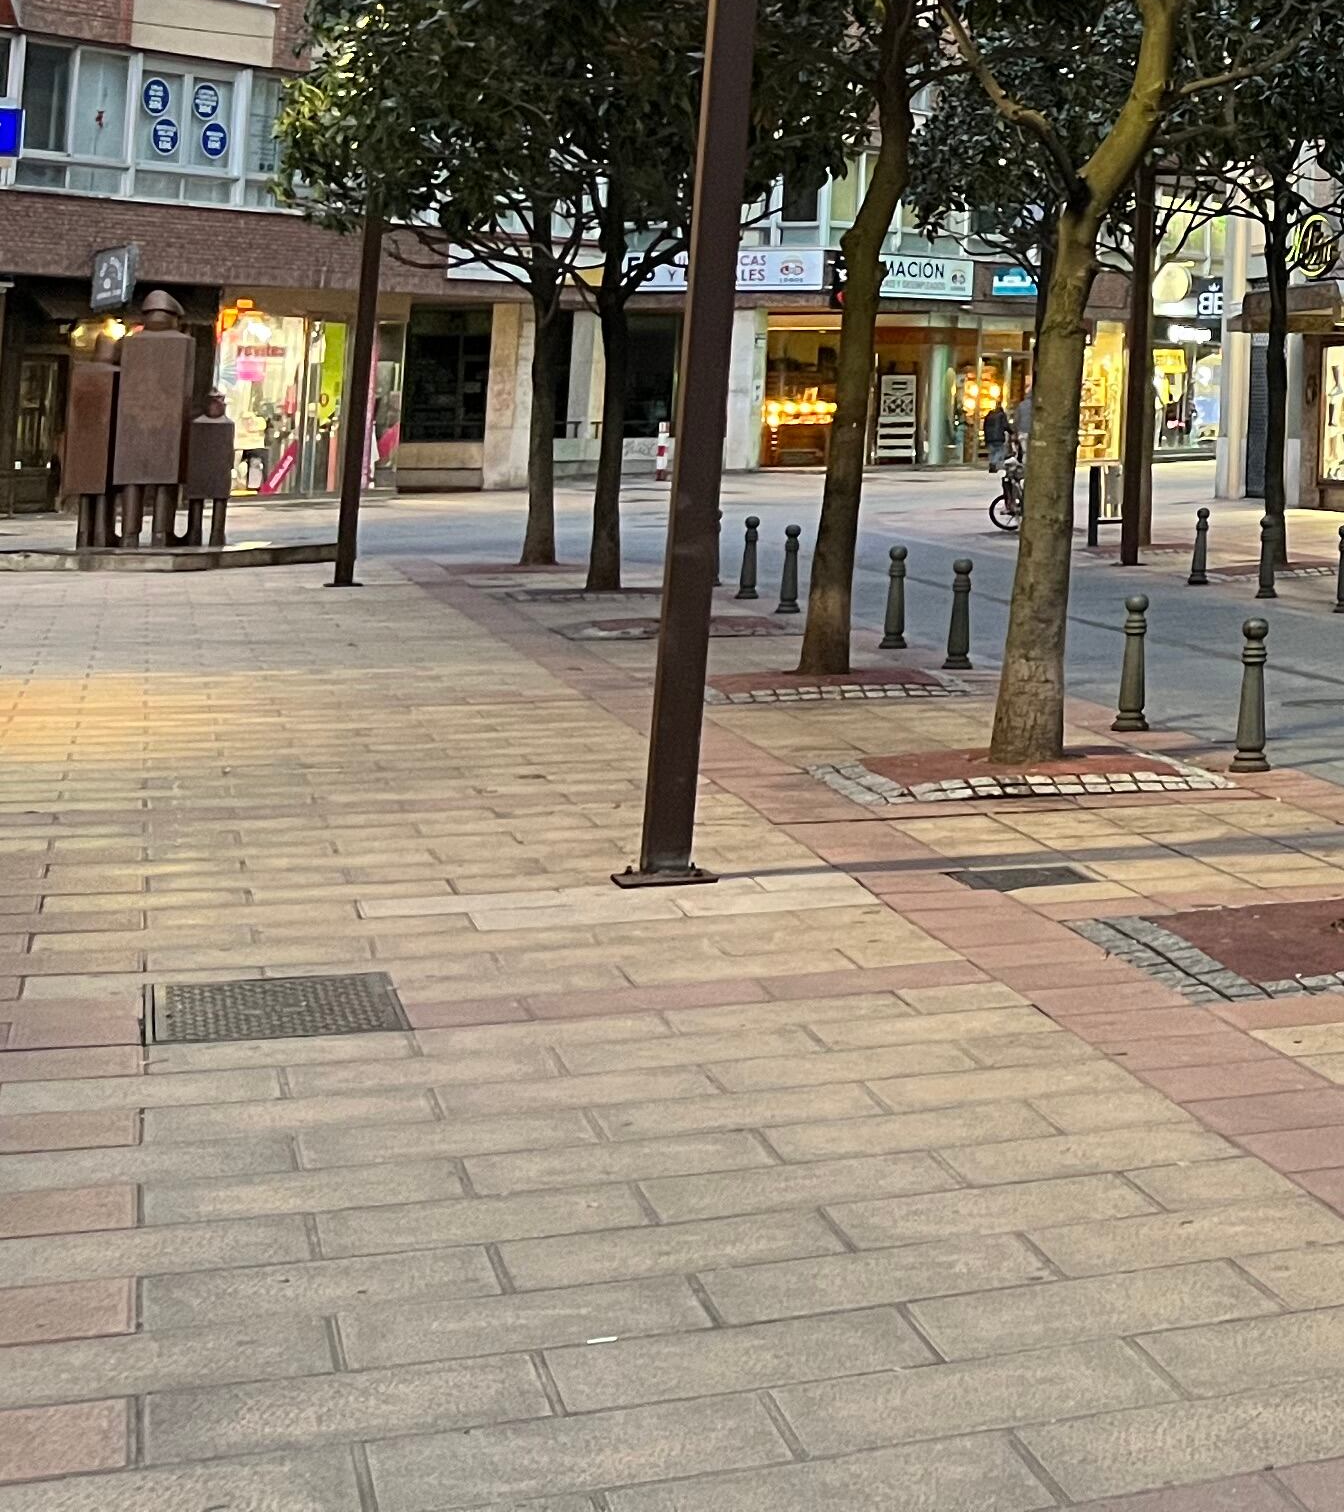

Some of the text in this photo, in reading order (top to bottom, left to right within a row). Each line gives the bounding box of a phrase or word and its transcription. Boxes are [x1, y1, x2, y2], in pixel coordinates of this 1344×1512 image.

[739, 254, 767, 267] CAS
[740, 268, 766, 282] LES
[886, 258, 945, 279] MACIÓN
